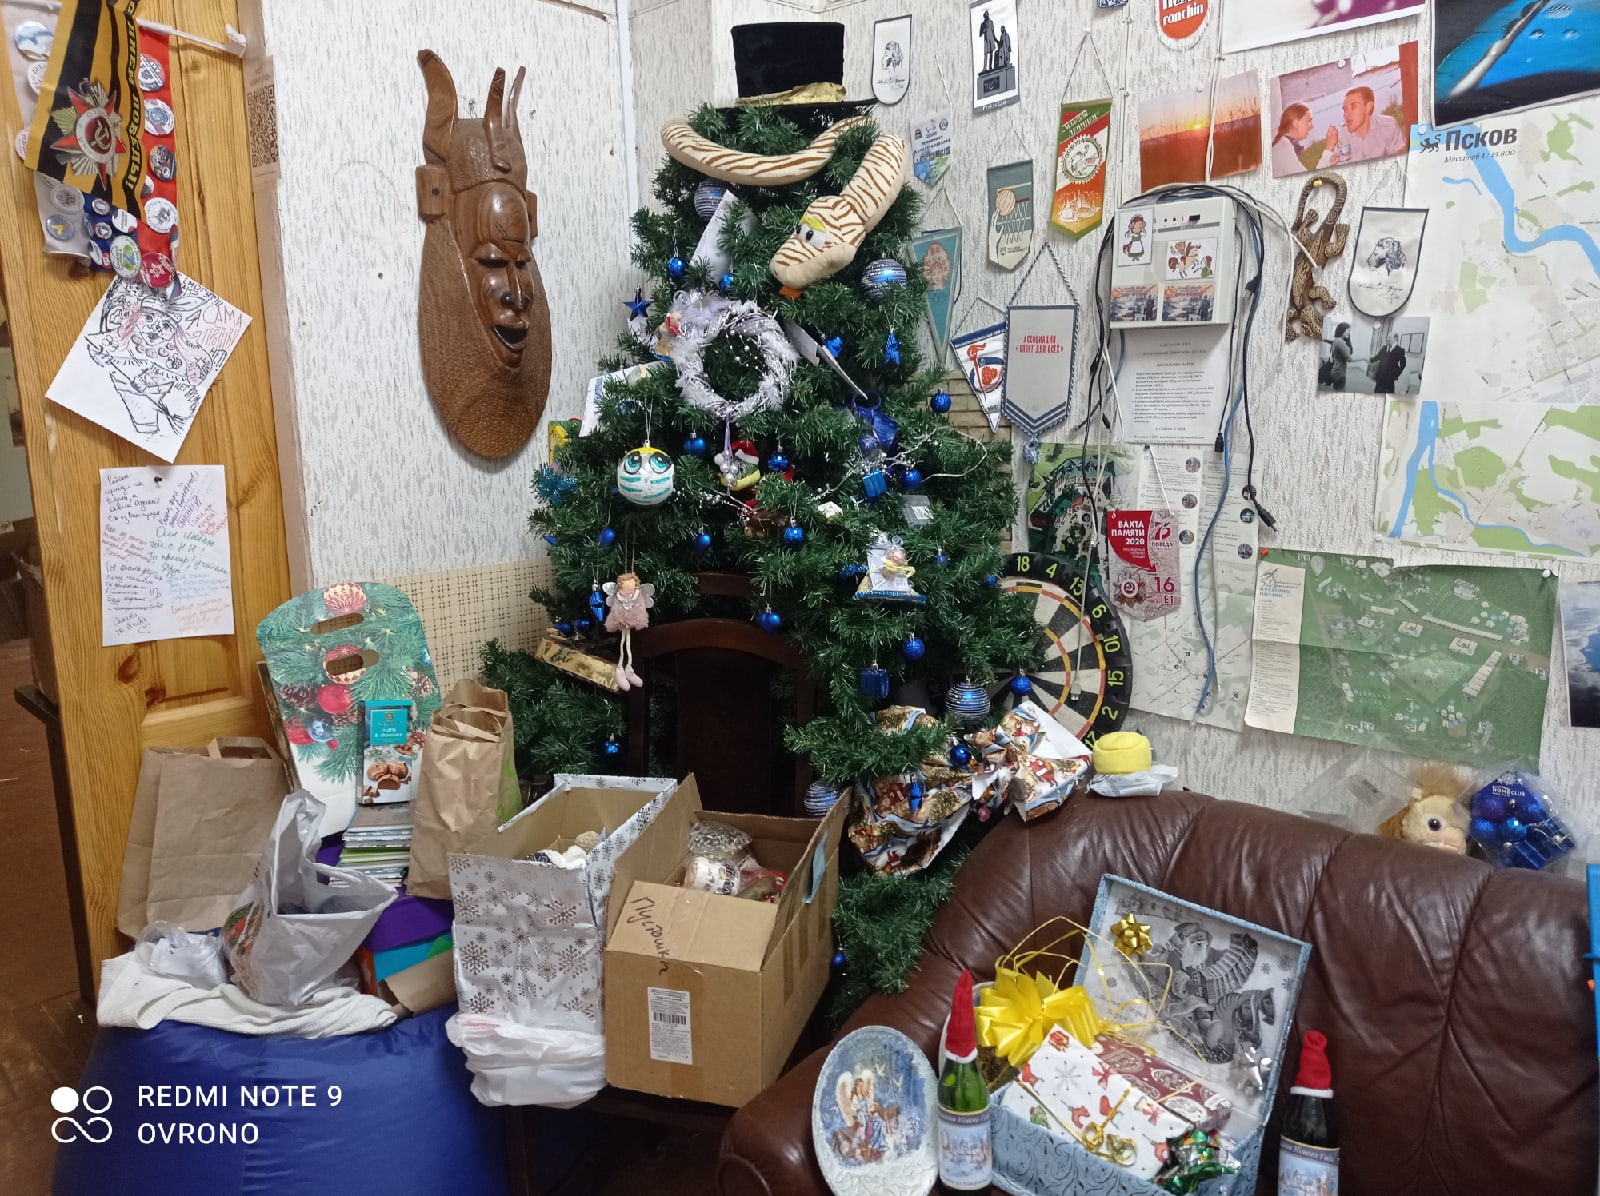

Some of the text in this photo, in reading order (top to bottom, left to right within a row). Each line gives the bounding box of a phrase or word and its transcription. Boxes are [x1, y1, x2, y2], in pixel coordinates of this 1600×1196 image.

[1162, 3, 1204, 26] ranchin
[126, 93, 141, 190] ПОБЕДЫ!
[1445, 128, 1518, 151] Псков
[1111, 528, 1145, 537] ПАМЯТИ
[1118, 520, 1145, 529] ВАХТА
[1125, 537, 1145, 545] 2020
[1016, 555, 1030, 573] 18
[1045, 563, 1058, 579] 4
[1069, 576, 1085, 596] 13
[1154, 576, 1175, 593] 16
[1091, 603, 1107, 619] 6
[1103, 634, 1121, 653] 10
[1107, 669, 1124, 687] 15
[1101, 706, 1119, 721] 2
